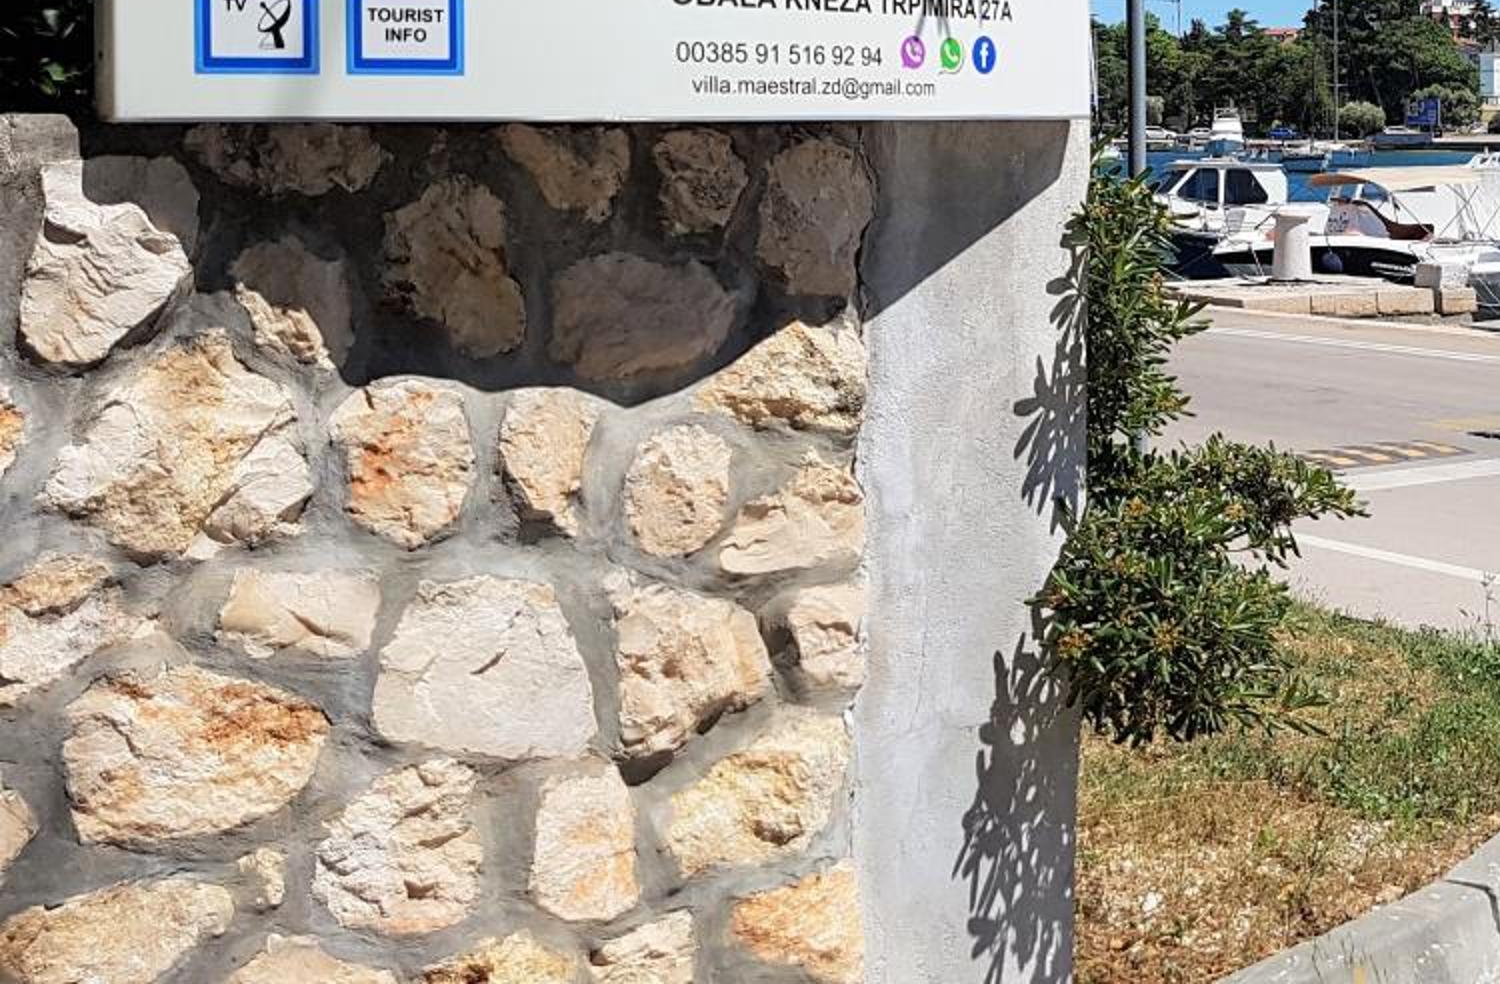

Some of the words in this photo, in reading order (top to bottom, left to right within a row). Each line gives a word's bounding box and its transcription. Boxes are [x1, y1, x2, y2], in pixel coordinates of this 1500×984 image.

[368, 7, 444, 23] TOURIST
[980, 0, 1013, 21] 27A
[384, 28, 427, 42] INFO
[675, 41, 748, 63] 00385
[756, 44, 780, 63] 91
[789, 44, 825, 65] 516
[832, 45, 855, 65] 92
[861, 46, 882, 66] 94
[692, 75, 935, 99] villa.maestral.zd@gmail.com
